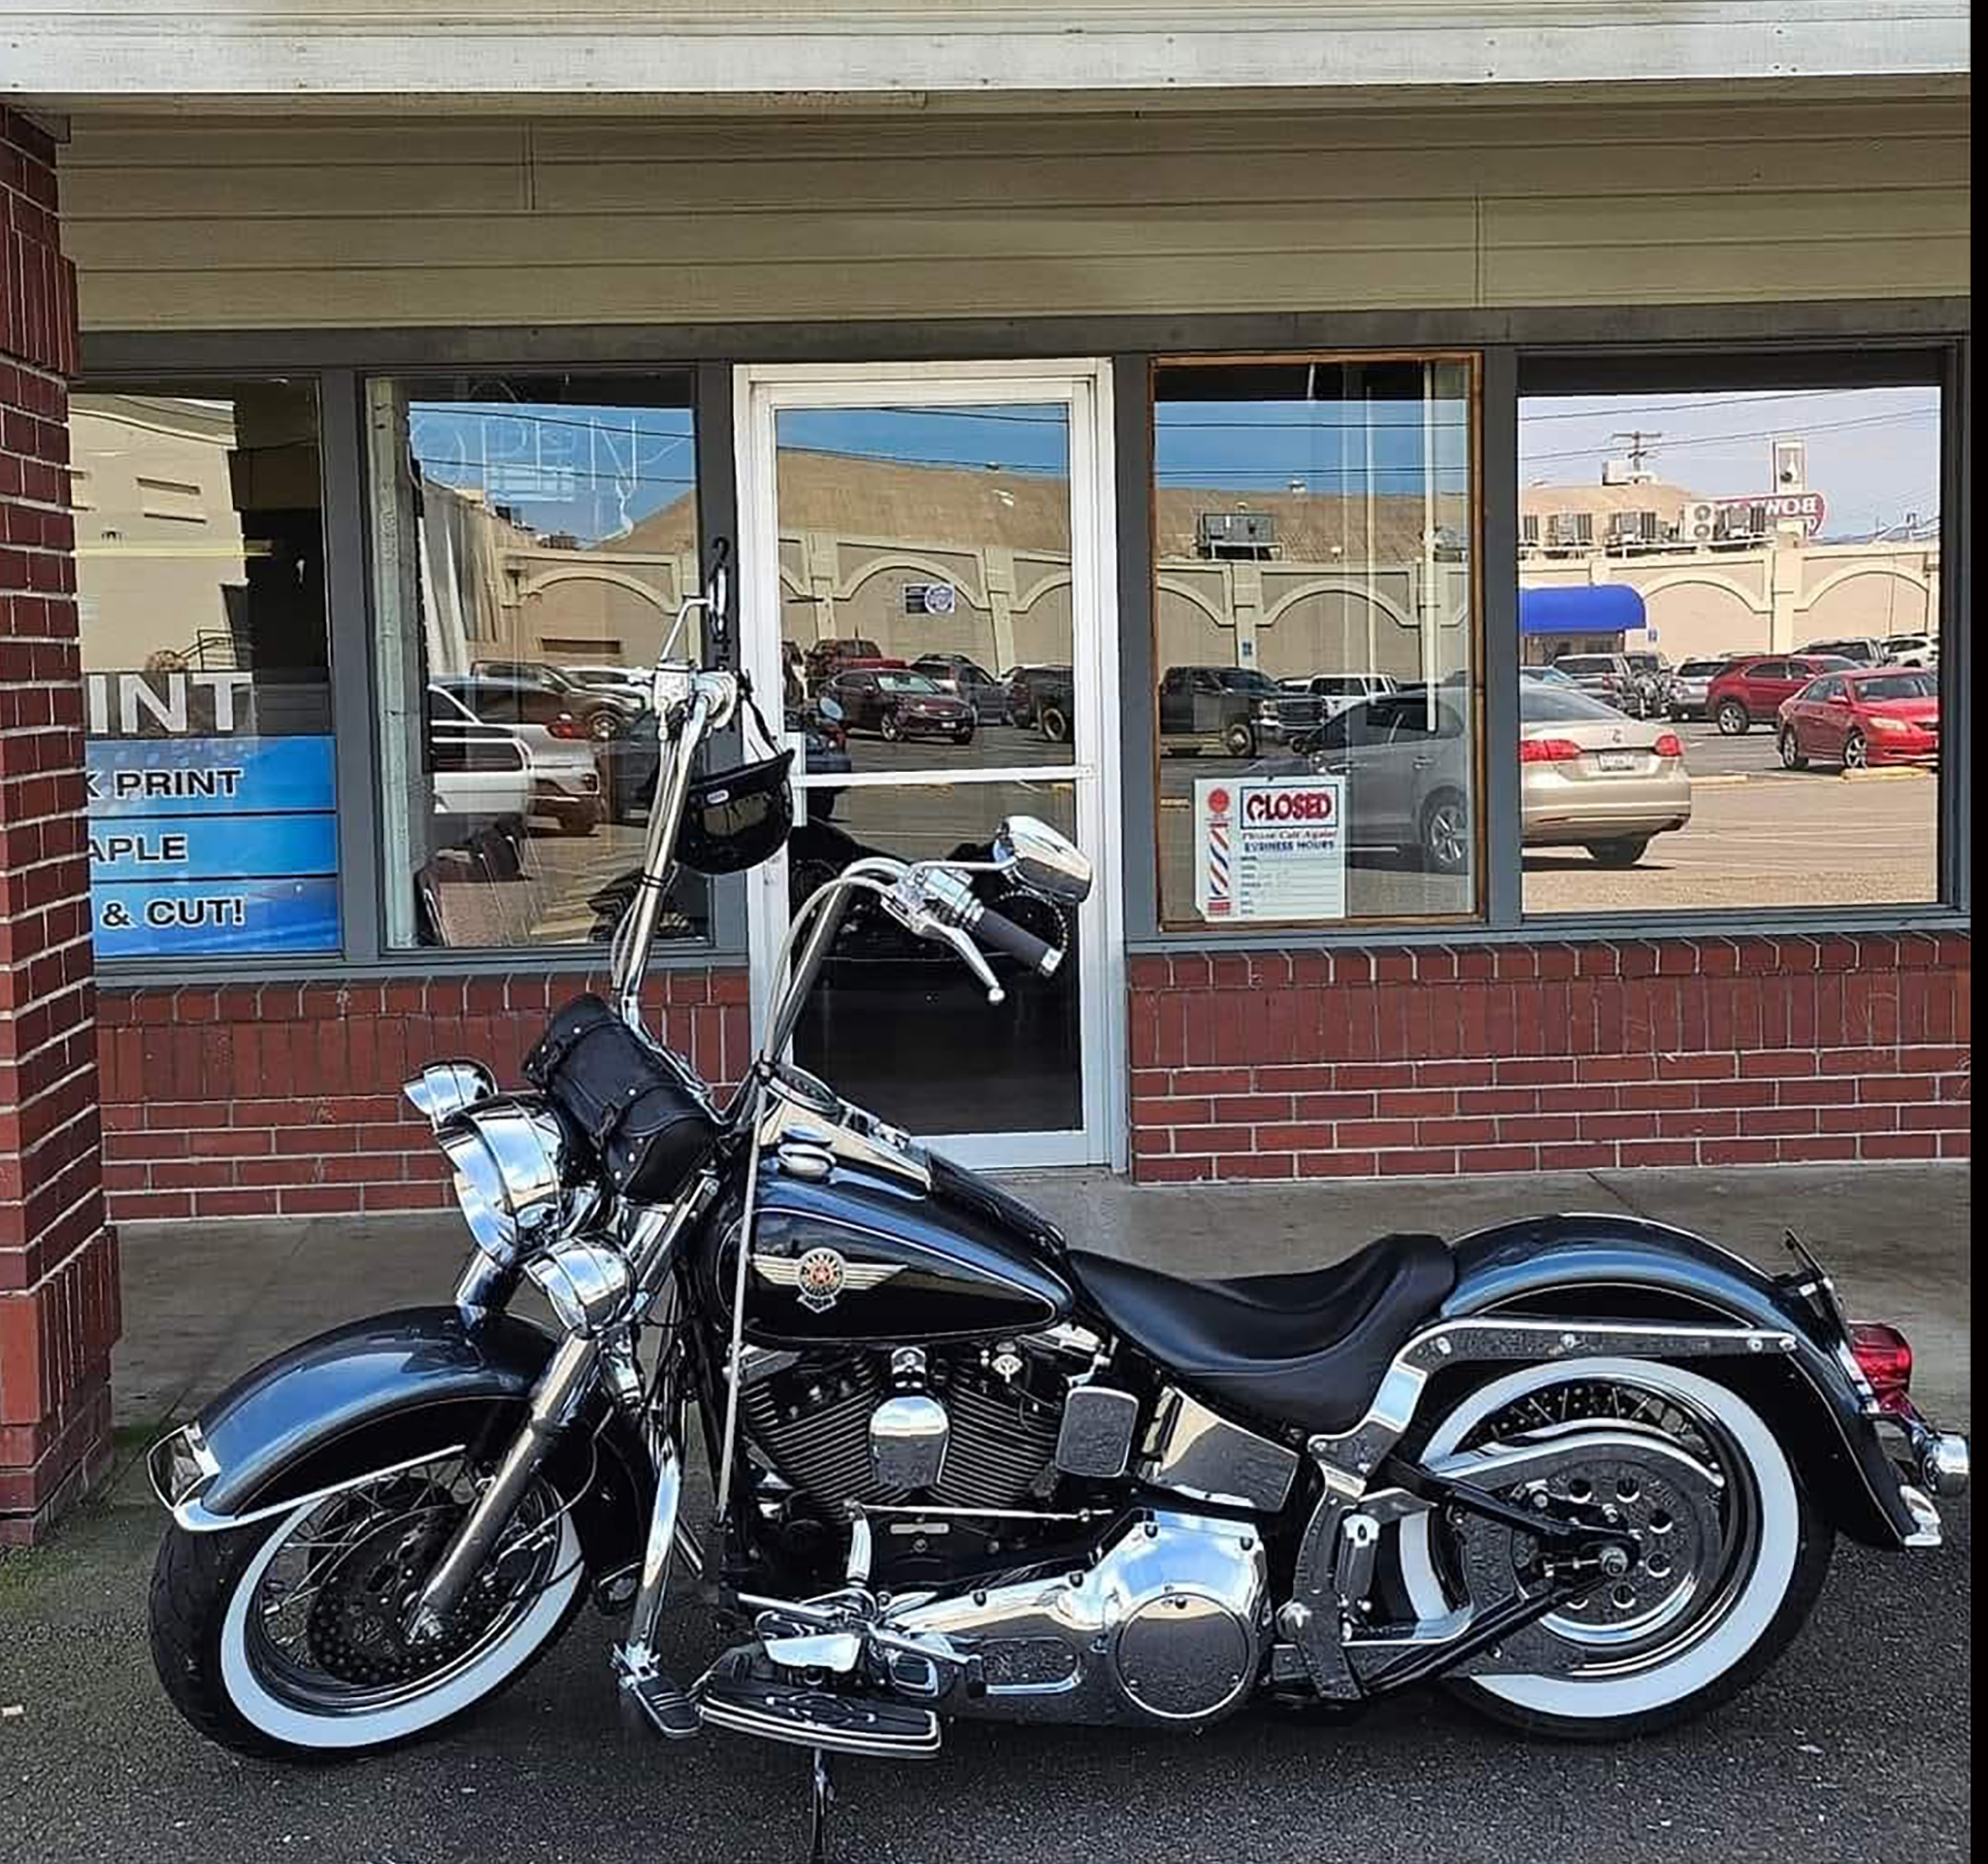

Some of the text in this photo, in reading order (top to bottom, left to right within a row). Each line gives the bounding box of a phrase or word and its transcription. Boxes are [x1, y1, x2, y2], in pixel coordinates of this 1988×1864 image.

[408, 415, 637, 491] OPEN
[88, 671, 252, 734] INT
[116, 770, 242, 798] PRINT
[1246, 792, 1333, 821] CLOSED
[1244, 841, 1335, 851] BUSINESS HOURS
[102, 899, 245, 927] & CUT!
